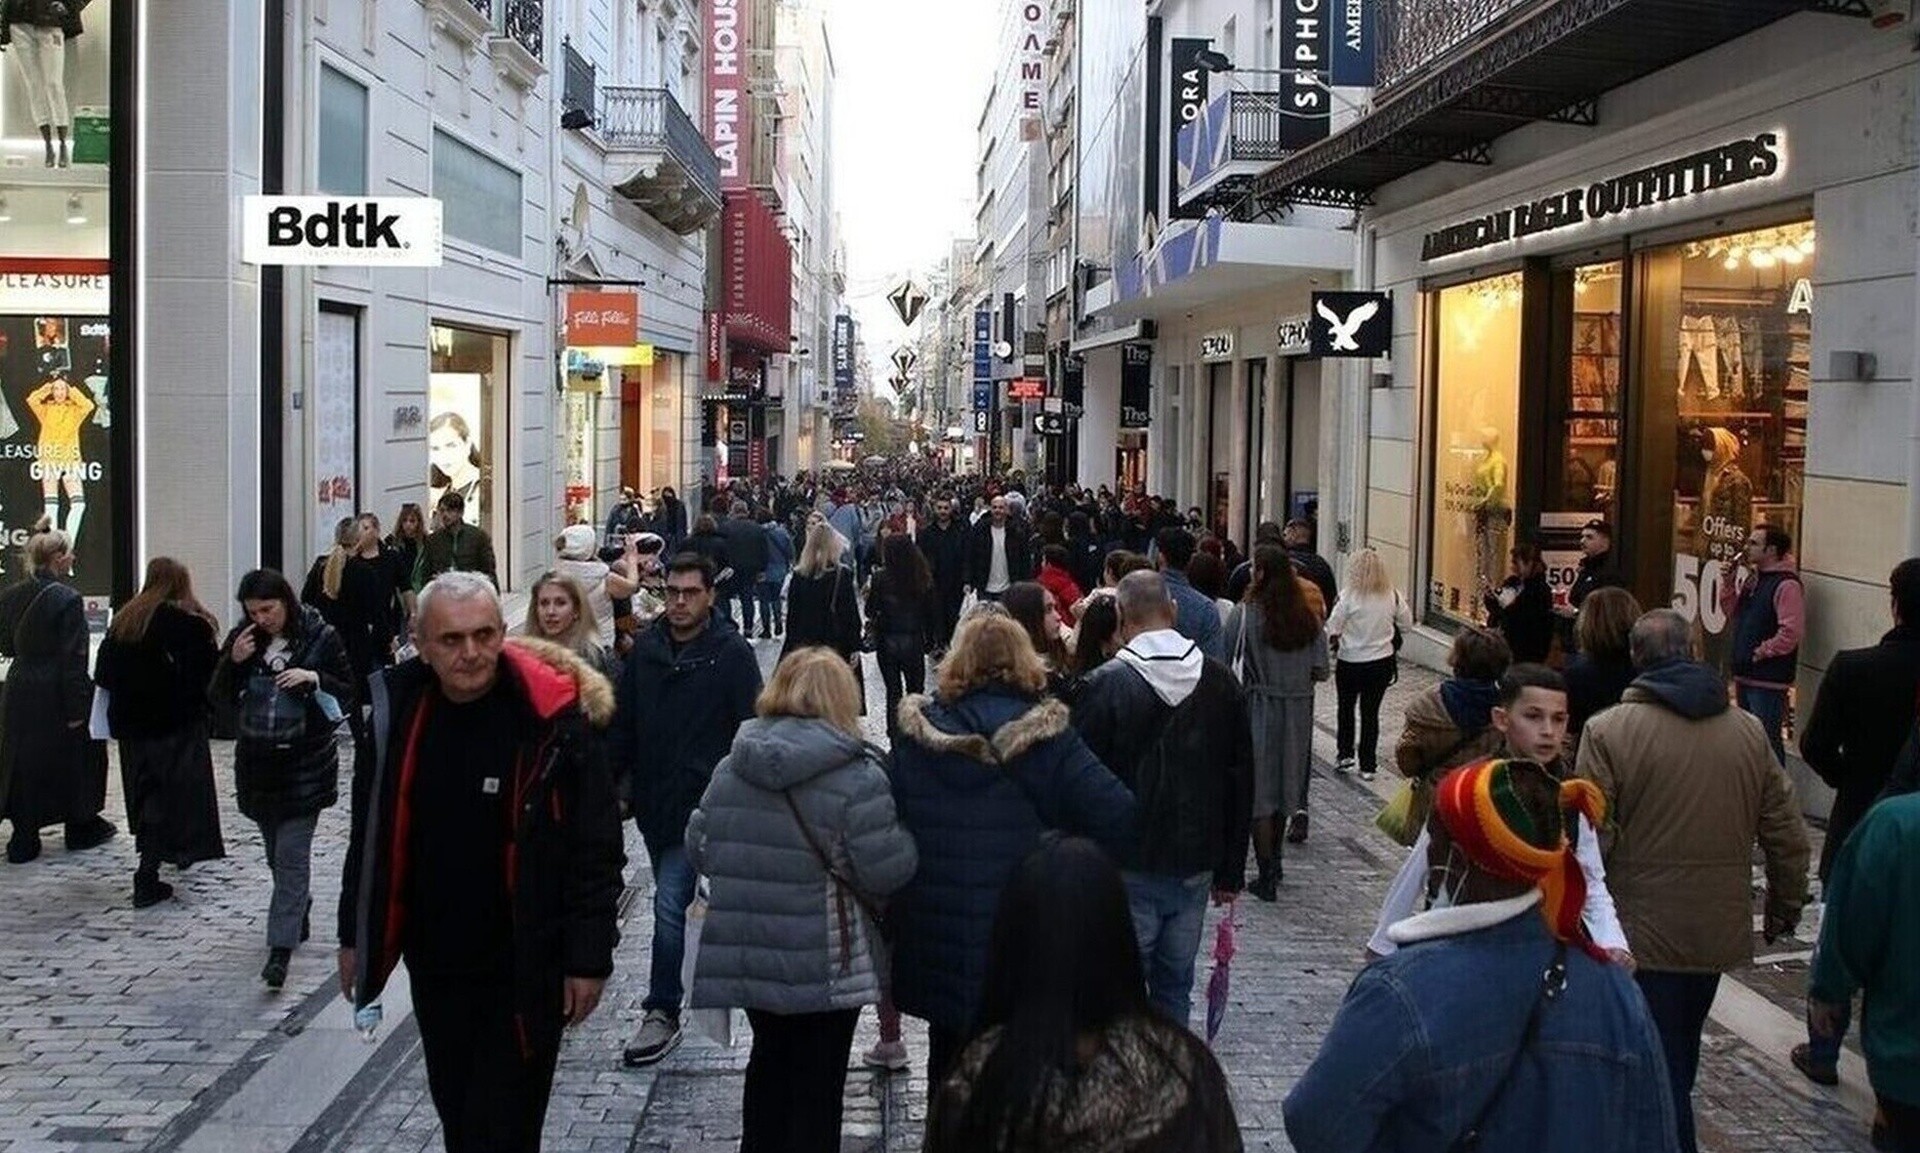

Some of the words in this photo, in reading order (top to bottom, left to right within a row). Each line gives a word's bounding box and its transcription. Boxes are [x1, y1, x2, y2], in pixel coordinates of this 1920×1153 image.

[1346, 0, 1363, 51] AME
[1181, 69, 1200, 124] ORA
[713, 89, 739, 177] LAPIN
[1586, 132, 1778, 219] OUTFITTERS
[0, 273, 104, 289] LEASURE
[1702, 515, 1745, 541] Offers
